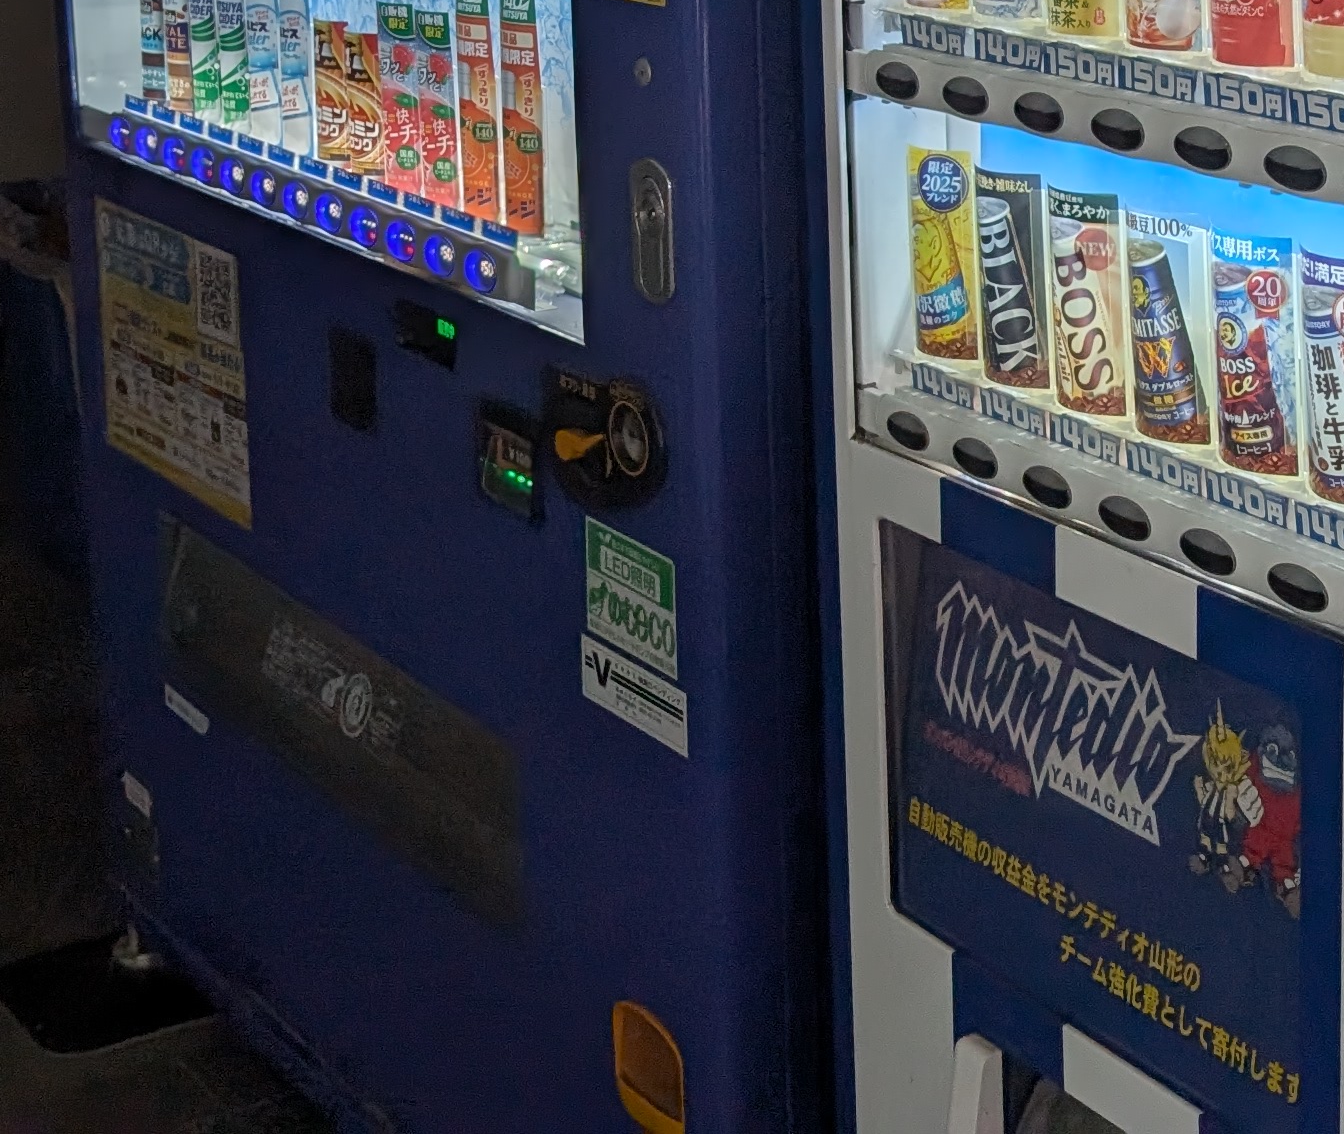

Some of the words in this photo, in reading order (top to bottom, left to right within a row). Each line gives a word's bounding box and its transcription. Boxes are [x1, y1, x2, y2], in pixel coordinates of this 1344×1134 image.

[905, 22, 963, 55] 140円
[976, 35, 1041, 67] 140円
[1044, 45, 1116, 87] 150円
[1125, 59, 1193, 102] 150円
[1207, 74, 1284, 119] 150円
[922, 174, 961, 195] 2025
[927, 160, 953, 175] 限定
[1076, 237, 1116, 259] NEW
[978, 220, 1040, 372] BLACK
[1250, 276, 1282, 300] 20
[1054, 254, 1115, 398] BOSS
[913, 364, 973, 409] 140円
[1220, 356, 1256, 374] BOSS
[1224, 373, 1260, 399] Ice
[981, 388, 1044, 437] 140円
[1052, 414, 1119, 465] 140円
[1126, 441, 1201, 496] 140円
[1207, 469, 1284, 529] 140円
[1049, 762, 1156, 835] YAMAGATA
[907, 793, 1202, 994] 自動販売機の収益金をモンテディオ山形の
